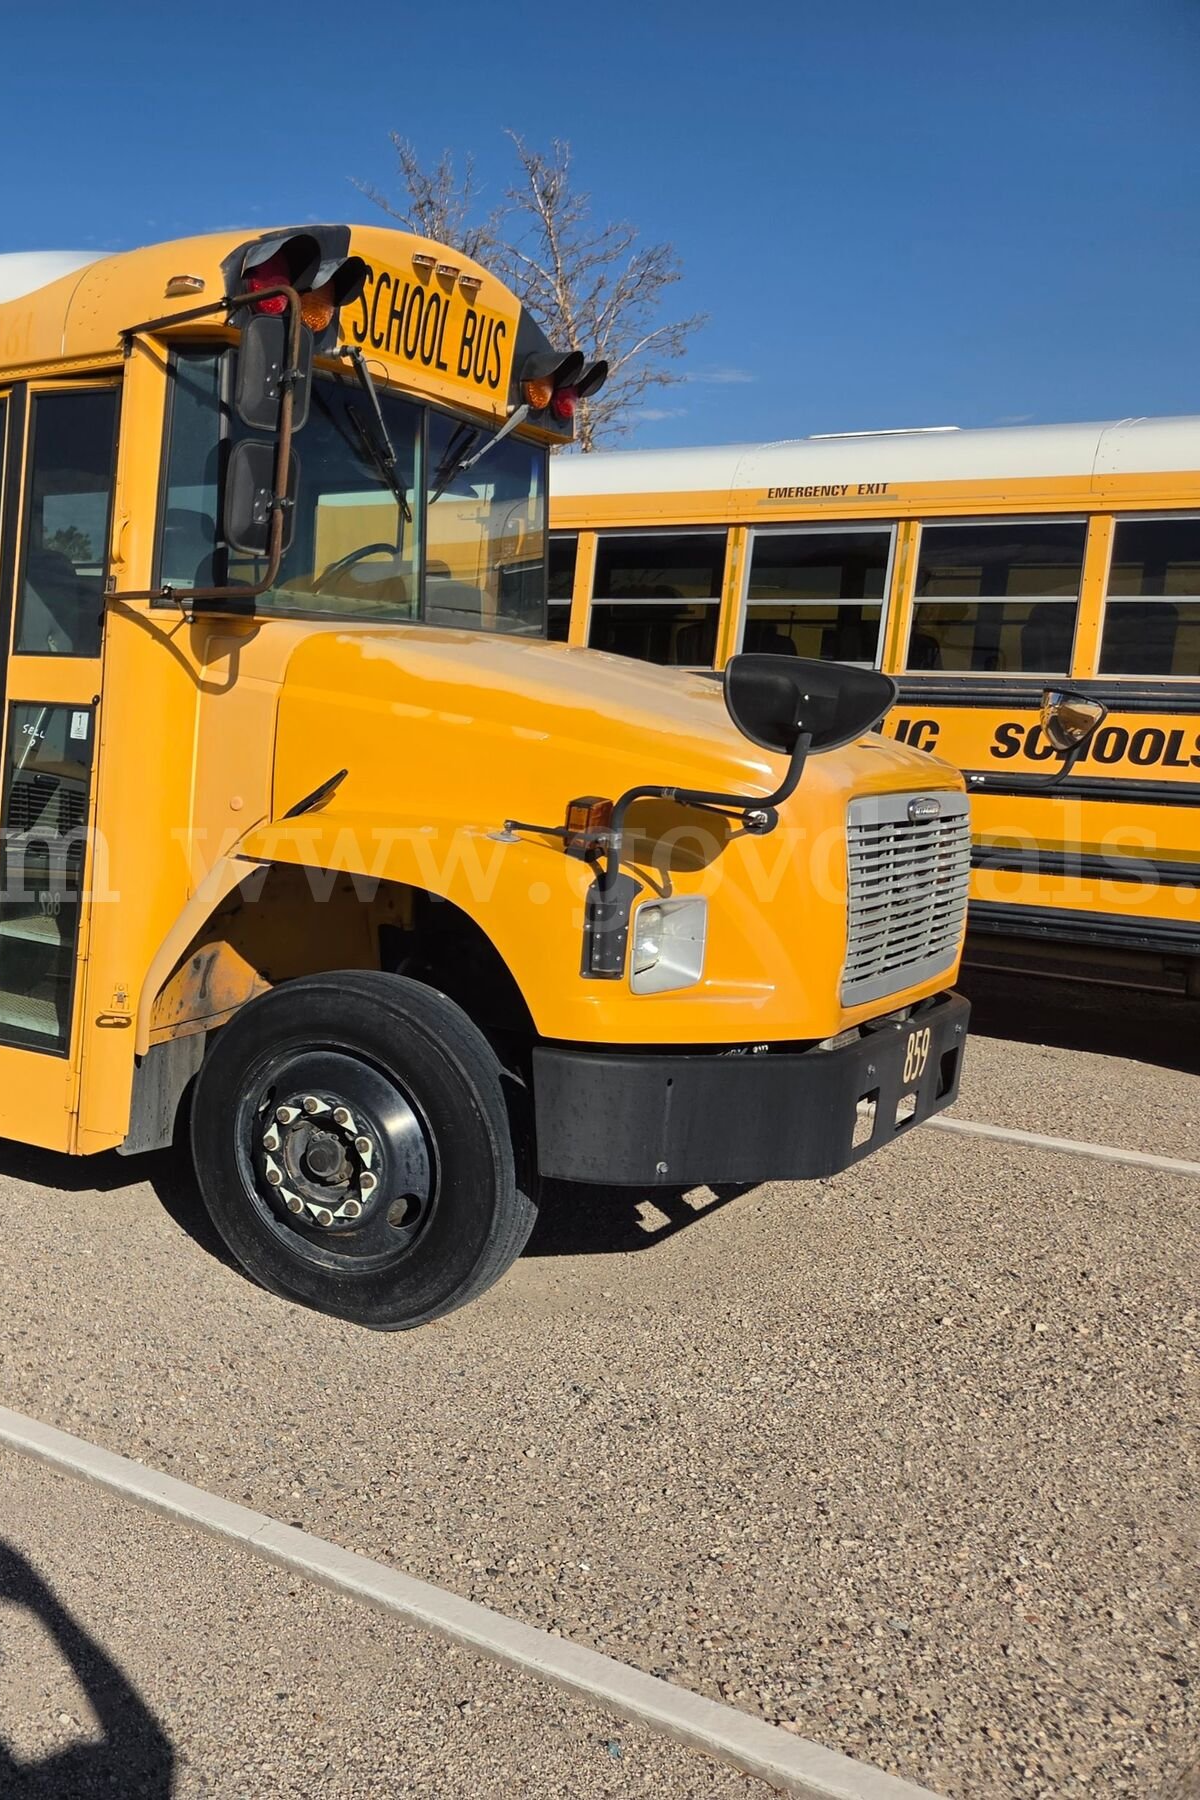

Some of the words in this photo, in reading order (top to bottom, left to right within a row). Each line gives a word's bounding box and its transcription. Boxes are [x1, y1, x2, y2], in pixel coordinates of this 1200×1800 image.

[352, 265, 450, 372] SCHOOL
[457, 308, 506, 389] BUS
[767, 485, 849, 499] EMERGENCY
[857, 483, 890, 495] EXIT
[989, 722, 1200, 767] SCOOL
[903, 1027, 930, 1084] 859
